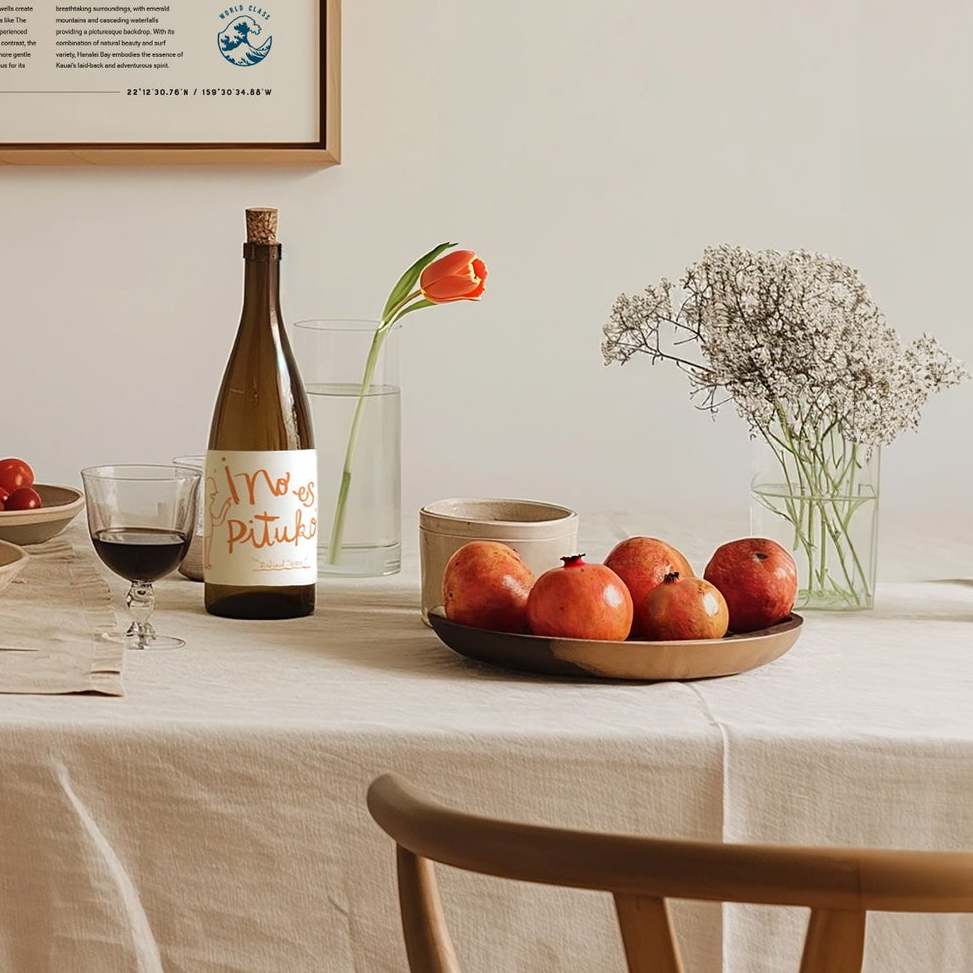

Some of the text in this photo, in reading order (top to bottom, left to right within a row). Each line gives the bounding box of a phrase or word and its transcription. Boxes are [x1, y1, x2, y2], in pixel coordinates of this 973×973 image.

[56, 5, 92, 14] breathtaking
[219, 4, 271, 20] WORLD CLASS
[100, 17, 129, 25] cascading
[56, 28, 82, 37] providing
[88, 28, 122, 37] picturesque
[121, 40, 141, 48] beauty
[13, 51, 31, 60] gentle
[100, 51, 111, 60] Bay
[292, 481, 315, 507] es
